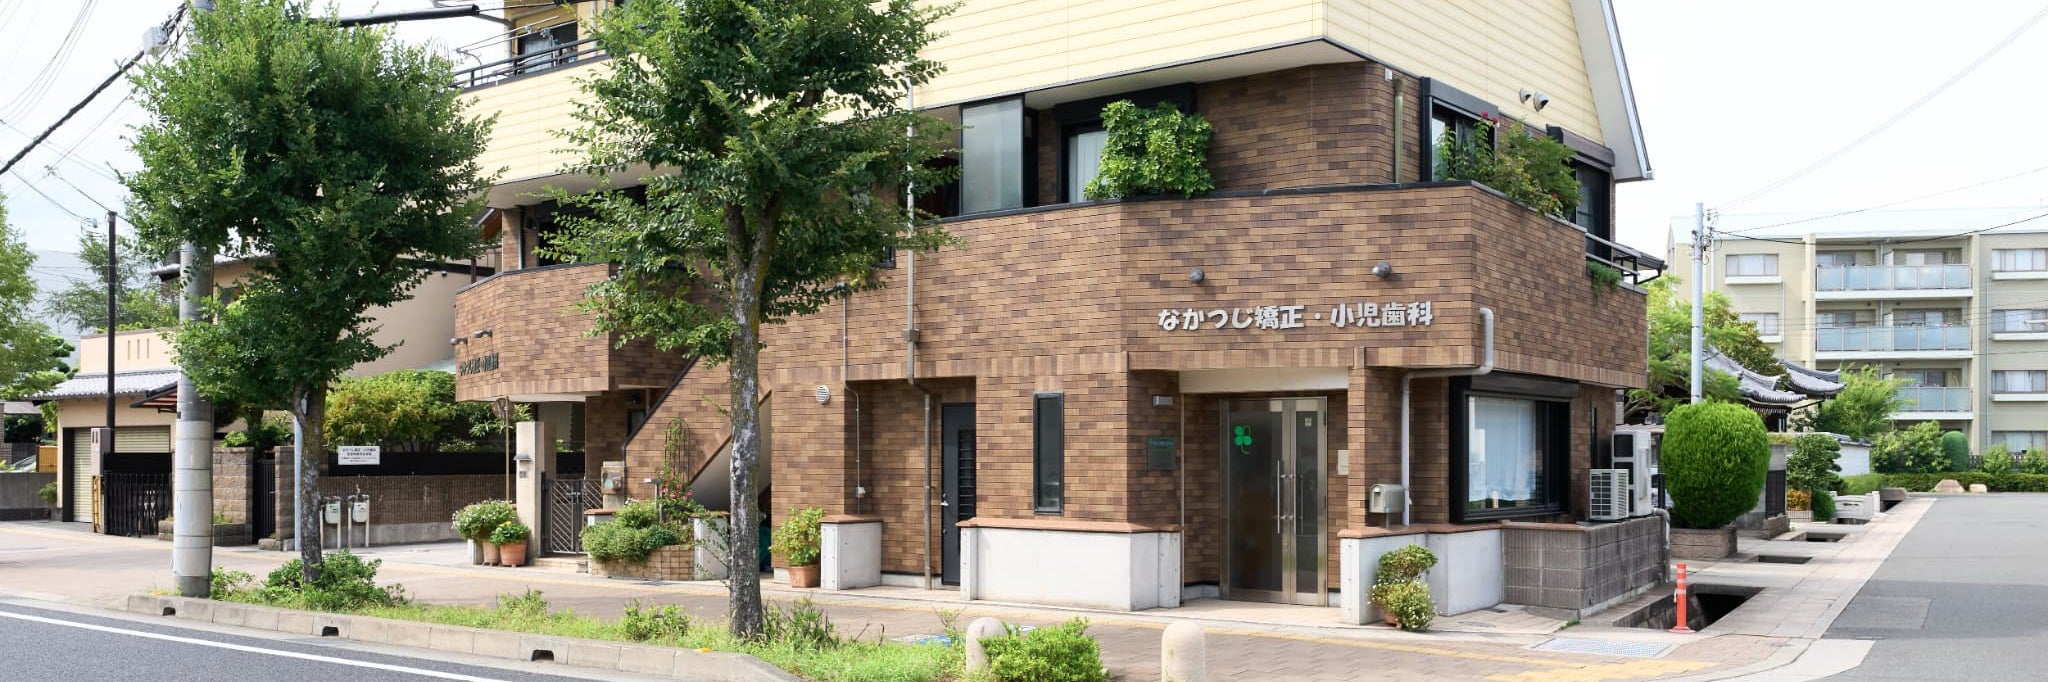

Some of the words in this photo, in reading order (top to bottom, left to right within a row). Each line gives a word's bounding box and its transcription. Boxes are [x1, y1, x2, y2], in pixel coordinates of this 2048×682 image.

[1158, 301, 1433, 331] なかつじ矯正・小児歯科
